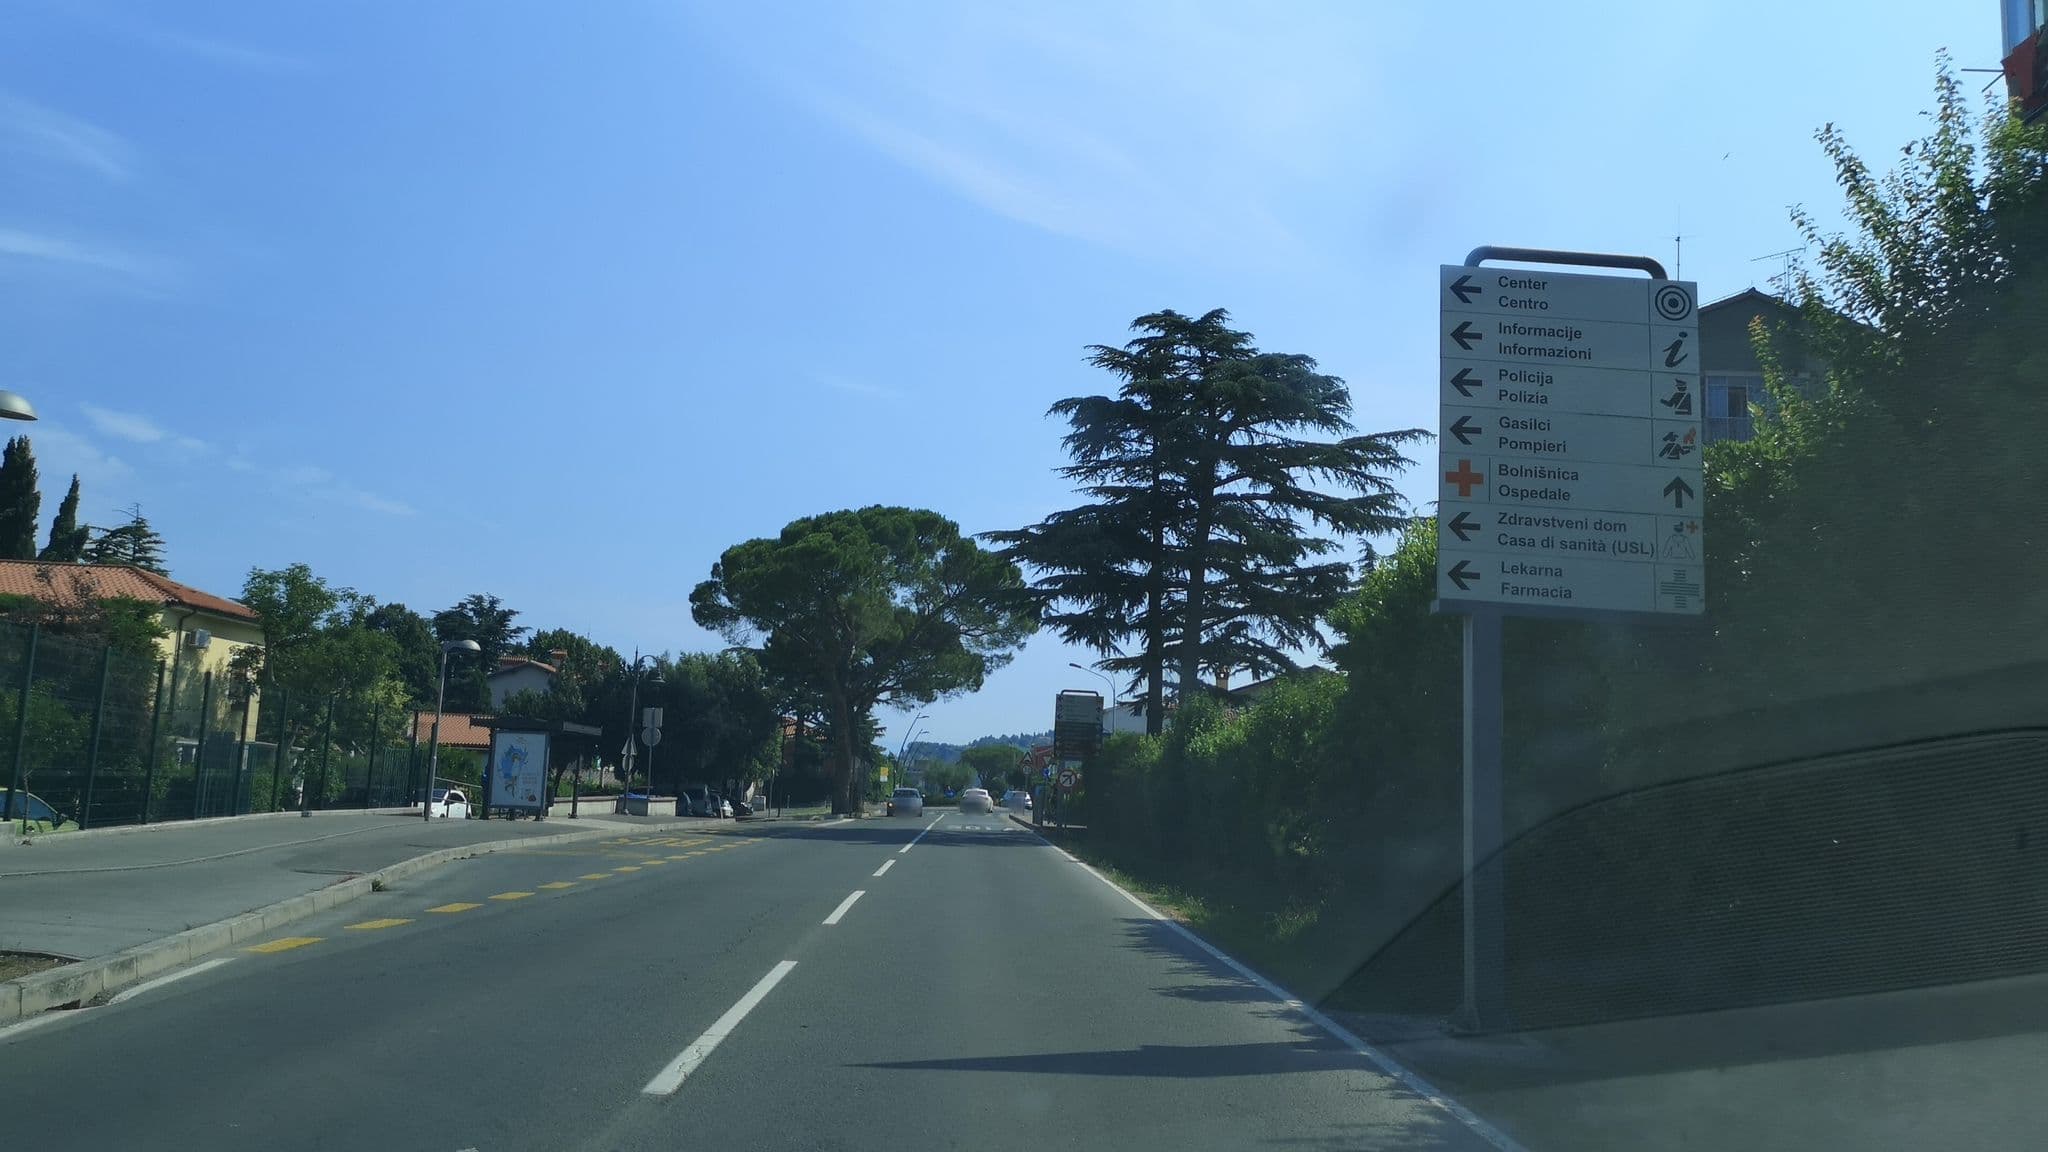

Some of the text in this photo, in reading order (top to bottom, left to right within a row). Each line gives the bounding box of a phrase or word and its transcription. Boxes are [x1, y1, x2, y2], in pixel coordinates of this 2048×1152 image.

[1497, 276, 1548, 291] Center
[1498, 296, 1549, 311] Centro
[1498, 322, 1583, 342] Informacije
[1498, 342, 1592, 361] Informazioni
[1498, 369, 1554, 387] Policija
[1498, 389, 1549, 405] Polizia
[1498, 417, 1551, 432] Gasilci
[1498, 437, 1567, 454] Pompieri
[1498, 464, 1579, 481] Bolnišnica
[1498, 485, 1571, 502] Ospedale
[1497, 512, 1627, 533] Zdravstveni dom
[1497, 533, 1655, 557] Casa di sanità (USL)
[1500, 561, 1563, 578] Lekarna
[1501, 582, 1572, 600] Farmacia
